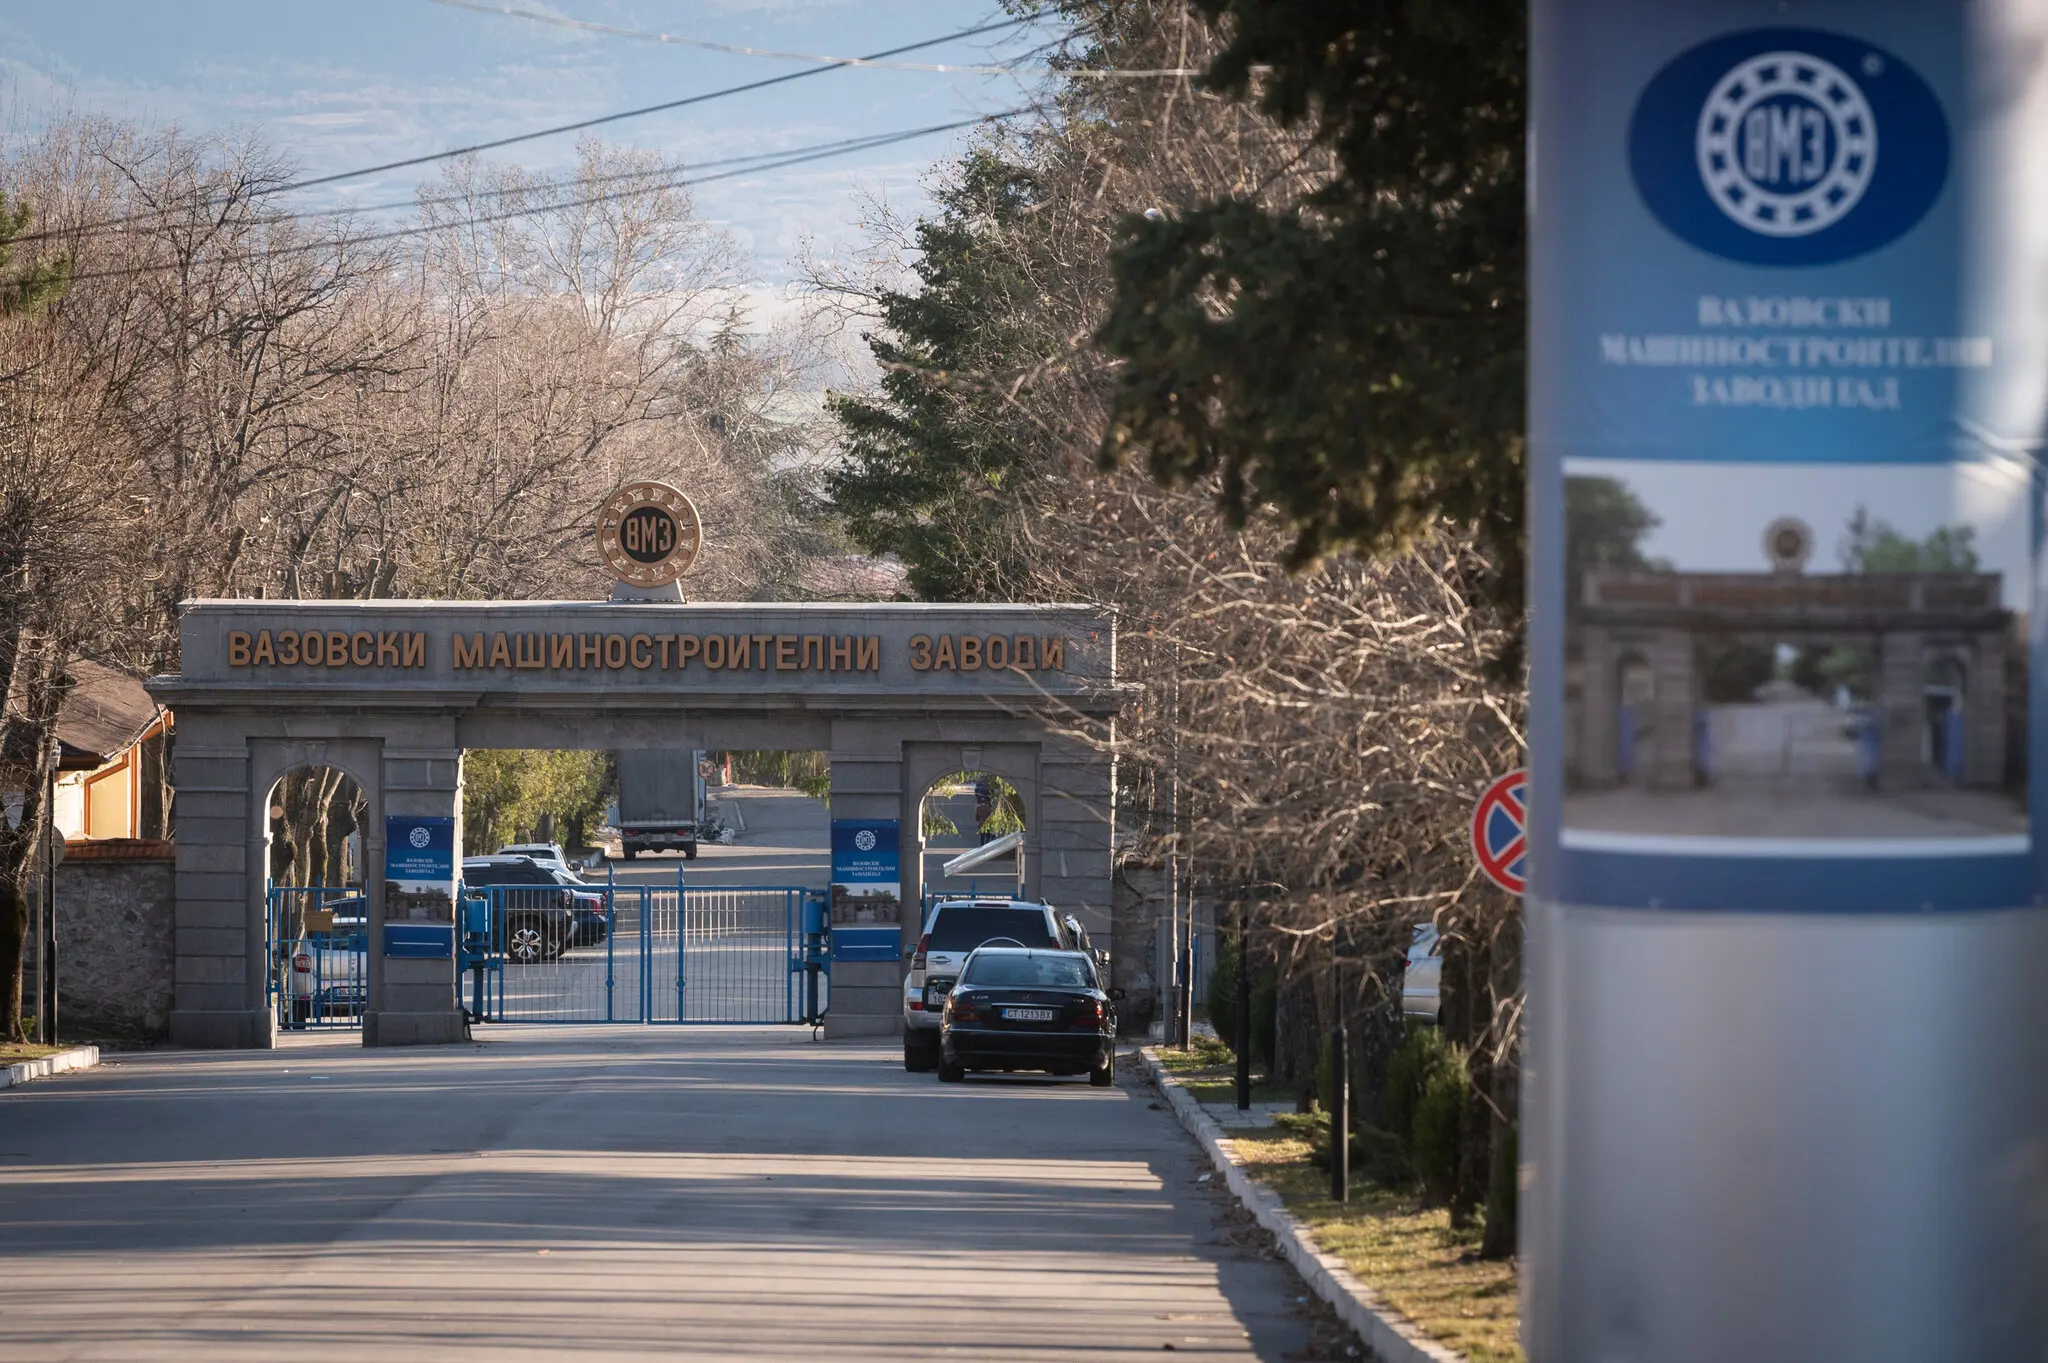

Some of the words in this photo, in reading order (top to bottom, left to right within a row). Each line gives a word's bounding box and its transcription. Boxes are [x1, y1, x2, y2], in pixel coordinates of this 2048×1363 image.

[626, 516, 672, 553] ВМЗ
[229, 629, 426, 667] ВАЗОВСКИ
[452, 632, 880, 671] МАШИНОСТРОИТЕЛНИ
[909, 634, 1065, 670] ЗАВОДИ
